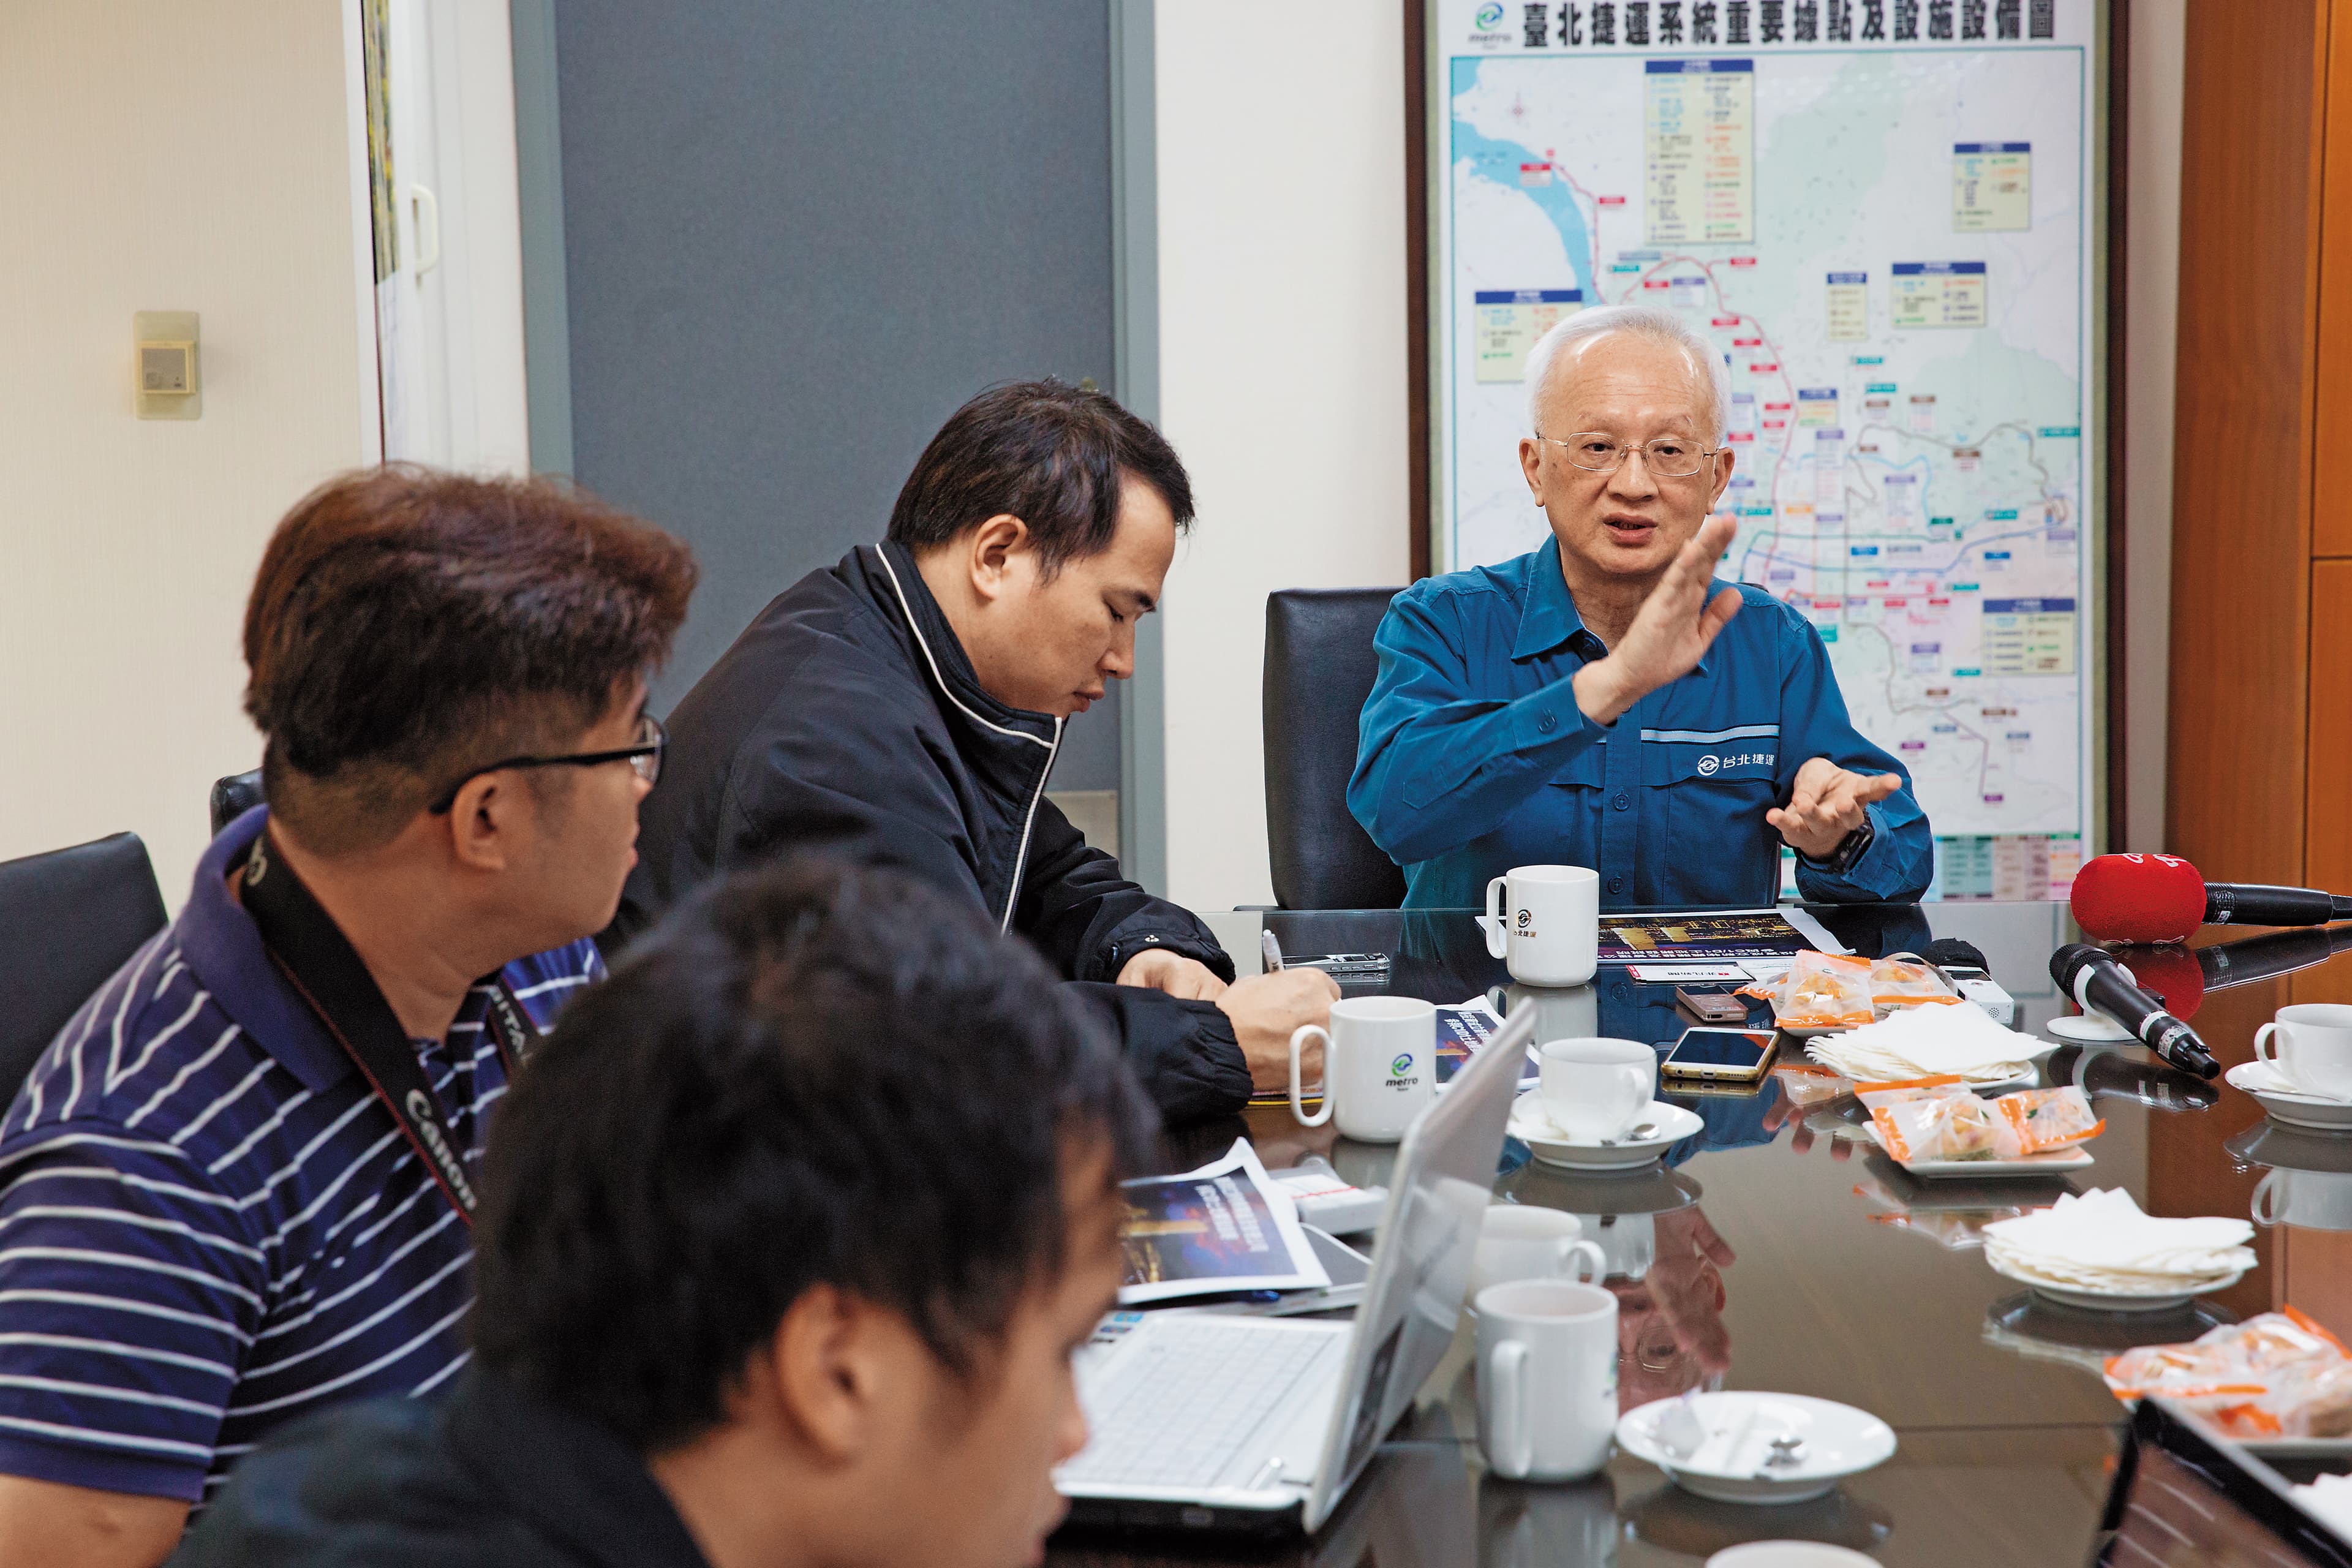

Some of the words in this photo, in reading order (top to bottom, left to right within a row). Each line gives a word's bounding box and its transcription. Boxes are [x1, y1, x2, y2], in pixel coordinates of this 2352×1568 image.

[1723, 753, 1774, 769] 台北捷運
[1385, 1077, 1419, 1087] metro
[406, 1088, 477, 1210] Canon
